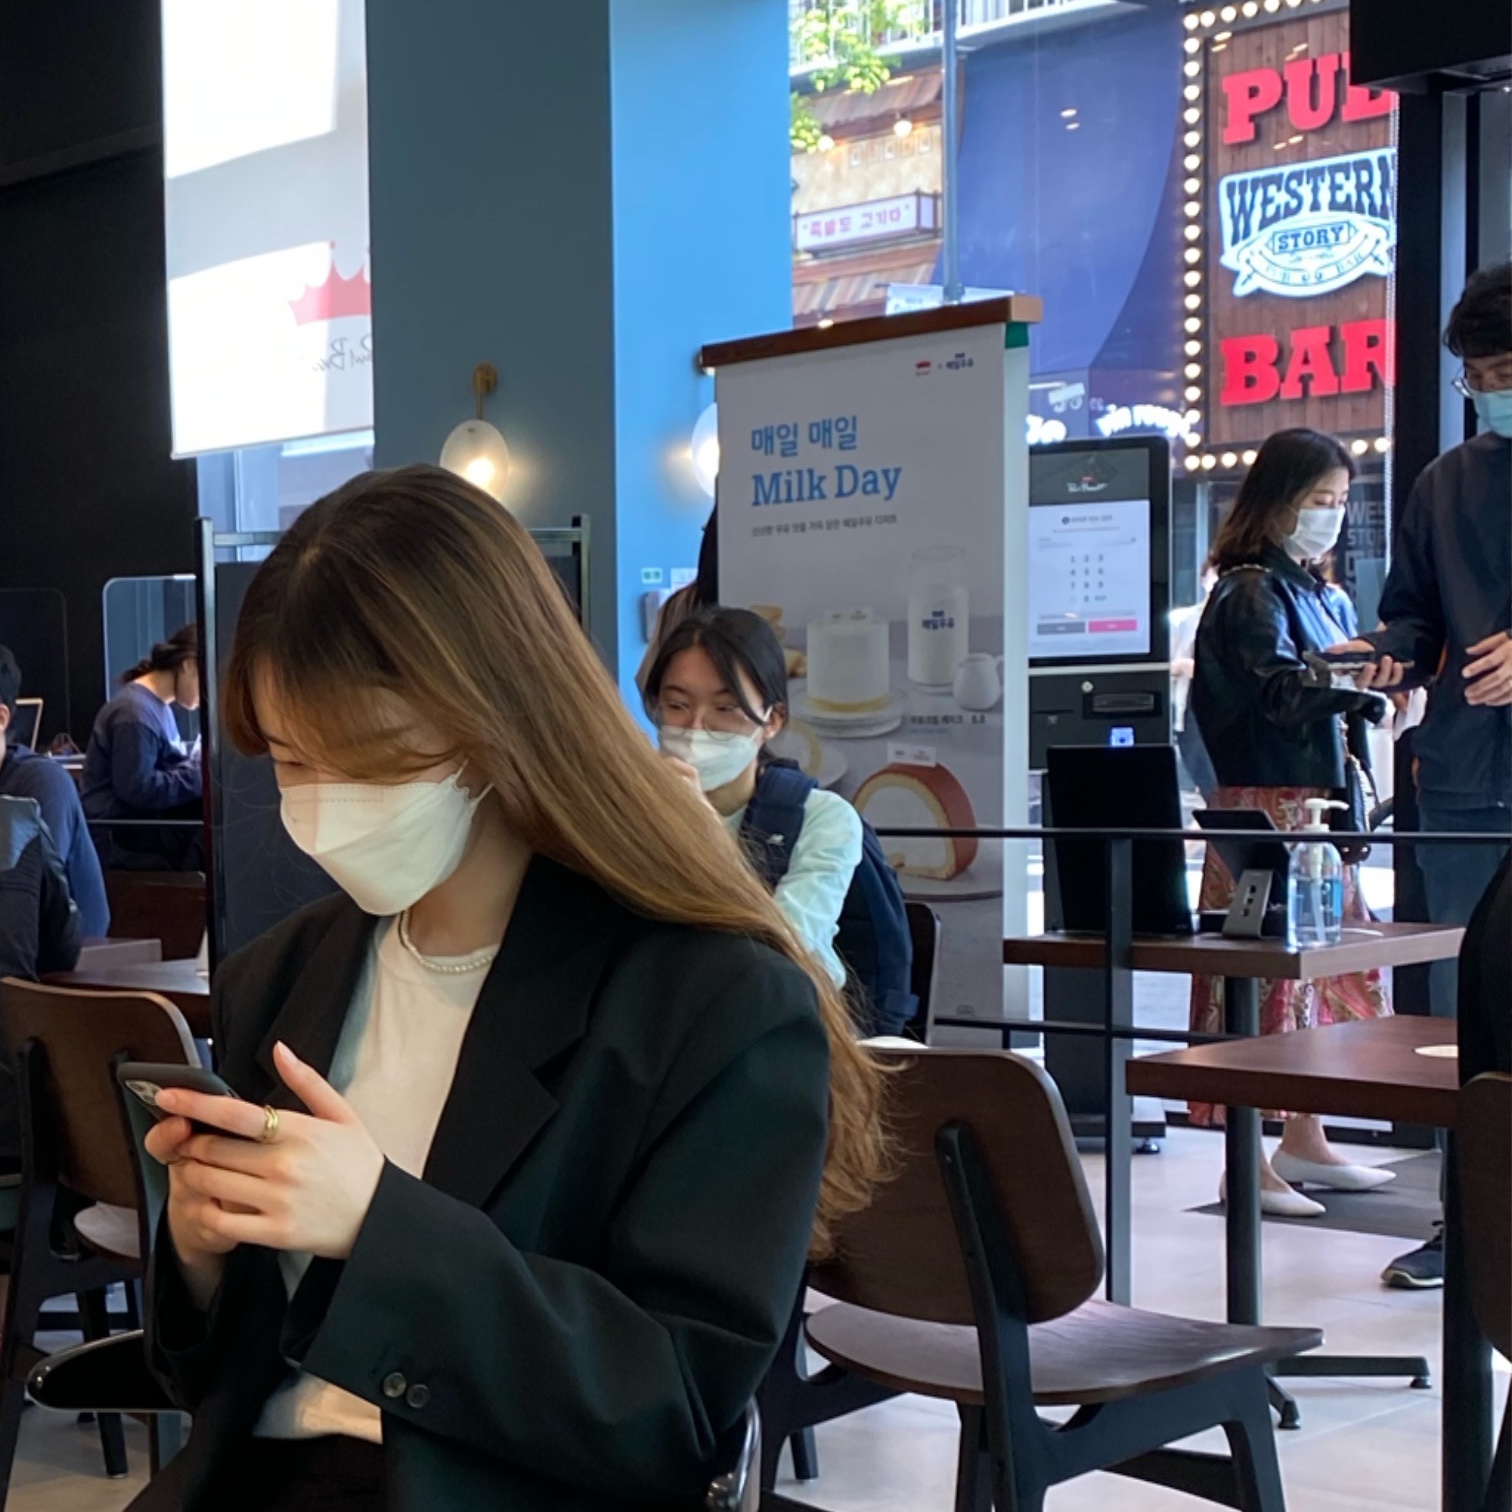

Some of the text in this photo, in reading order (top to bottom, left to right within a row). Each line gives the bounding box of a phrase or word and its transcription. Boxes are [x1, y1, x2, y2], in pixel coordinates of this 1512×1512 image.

[1278, 225, 1344, 251] STORY
[1220, 318, 1395, 407] BAR
[751, 415, 858, 458] 매일 매일
[751, 463, 903, 507] Milk Day
